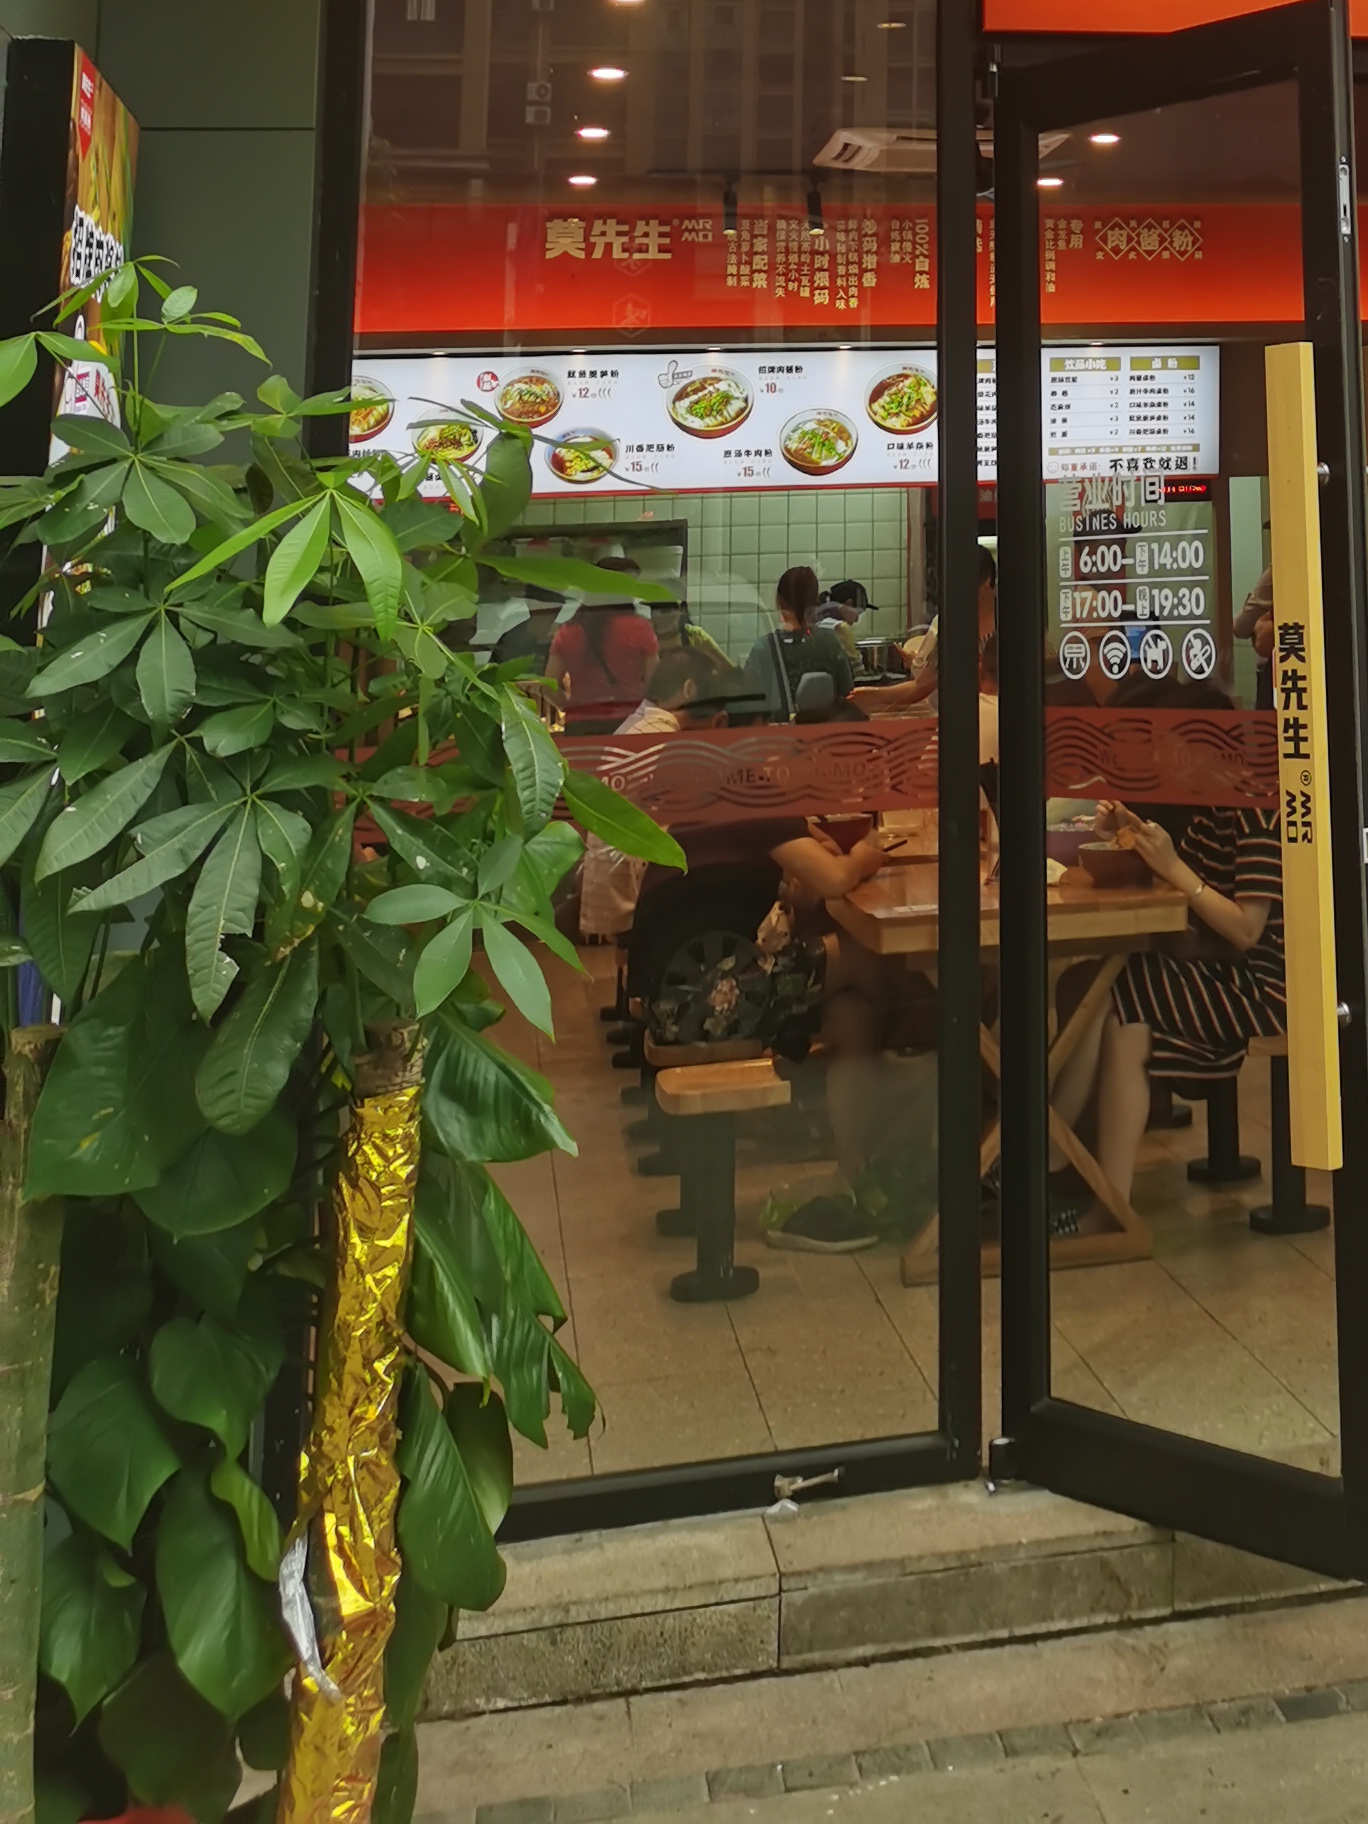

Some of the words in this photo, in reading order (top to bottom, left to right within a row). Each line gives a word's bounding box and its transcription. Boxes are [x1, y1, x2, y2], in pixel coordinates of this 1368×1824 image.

[545, 218, 672, 259] 莫先生
[1123, 509, 1167, 528] HOURS
[1151, 540, 1204, 569] 14:00
[1152, 587, 1205, 616] 19:30
[1278, 622, 1311, 760] 莫先生
